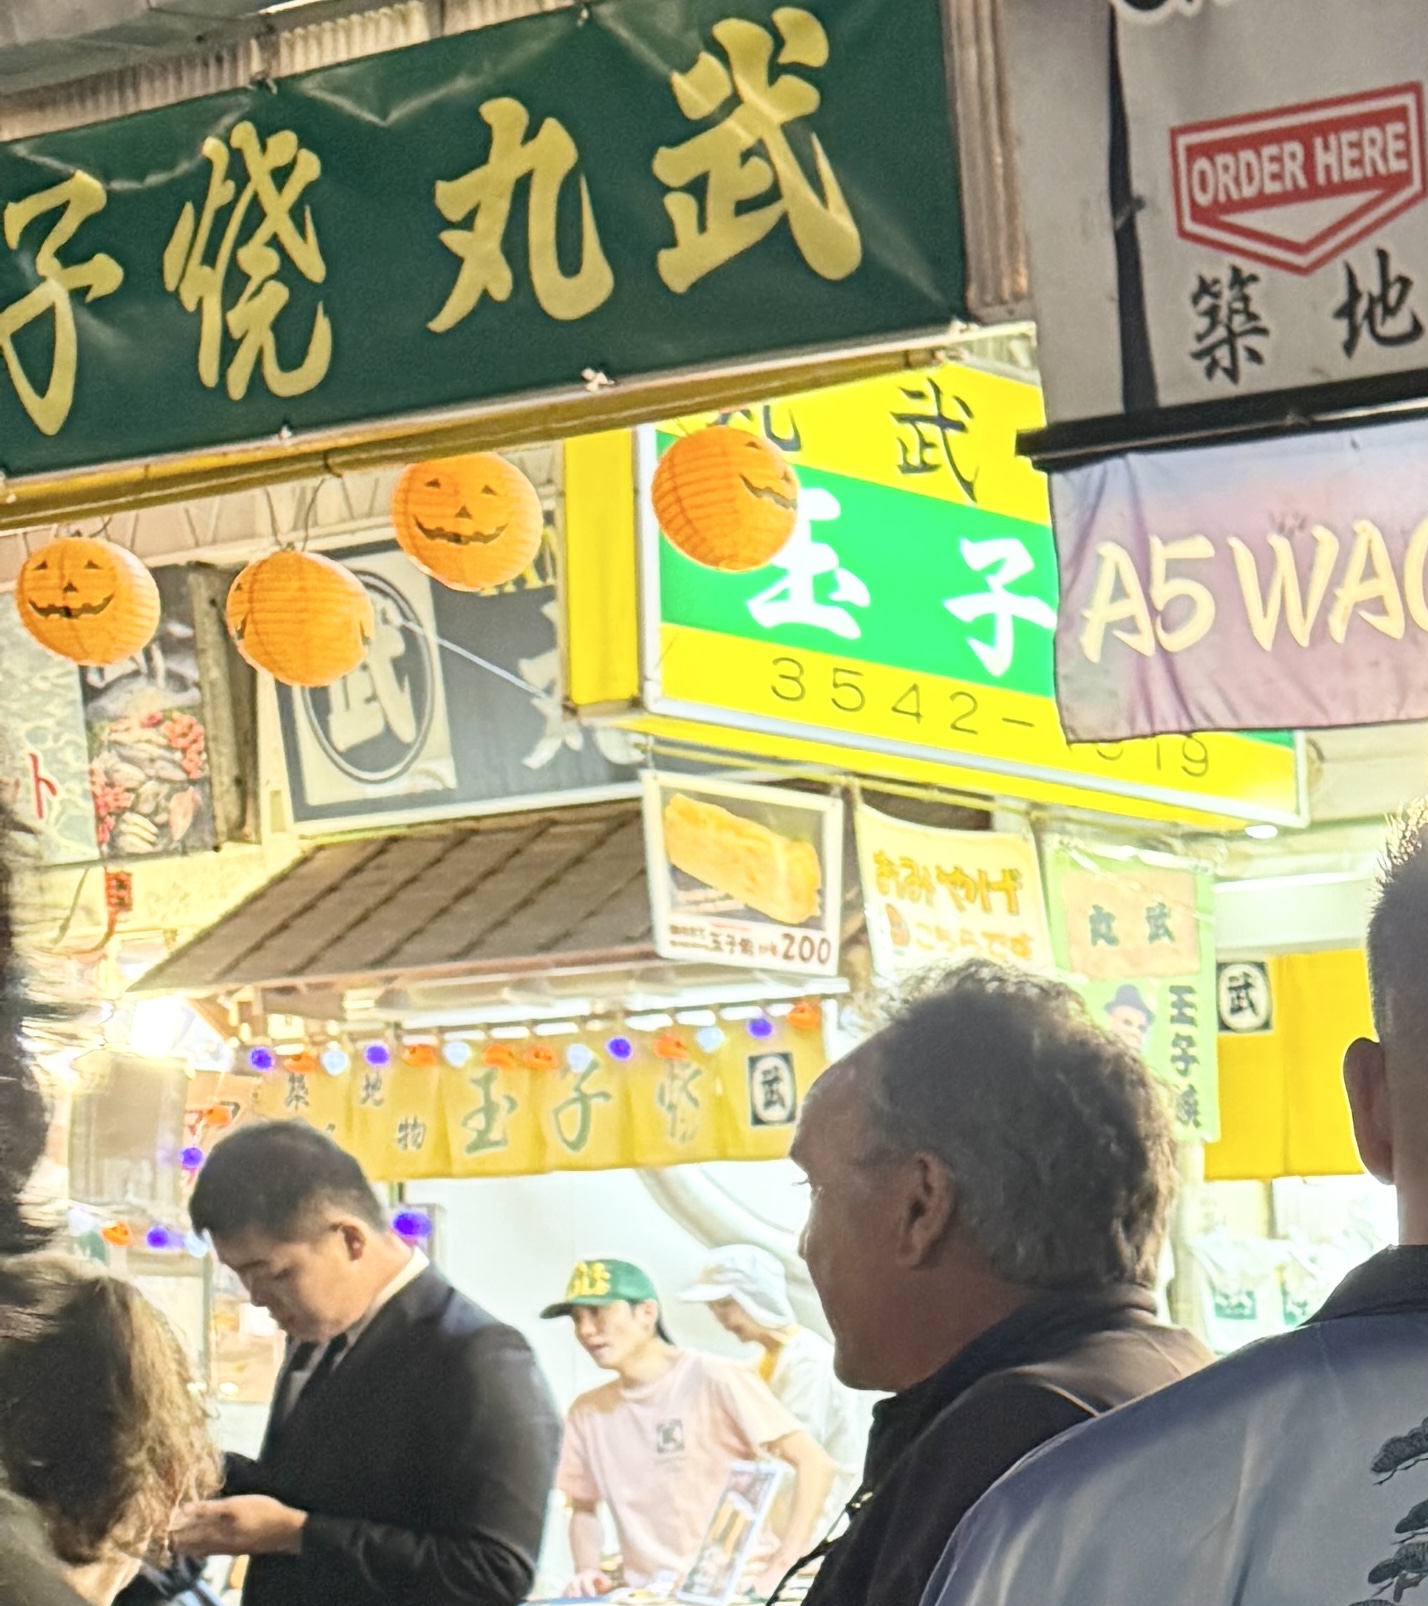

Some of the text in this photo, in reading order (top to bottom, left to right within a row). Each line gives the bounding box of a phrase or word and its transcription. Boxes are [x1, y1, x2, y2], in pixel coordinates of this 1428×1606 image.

[1191, 121, 1410, 207] ORDER HERE
[1190, 248, 1424, 385] 築地
[1080, 536, 1217, 664] A5
[780, 933, 832, 966] 200
